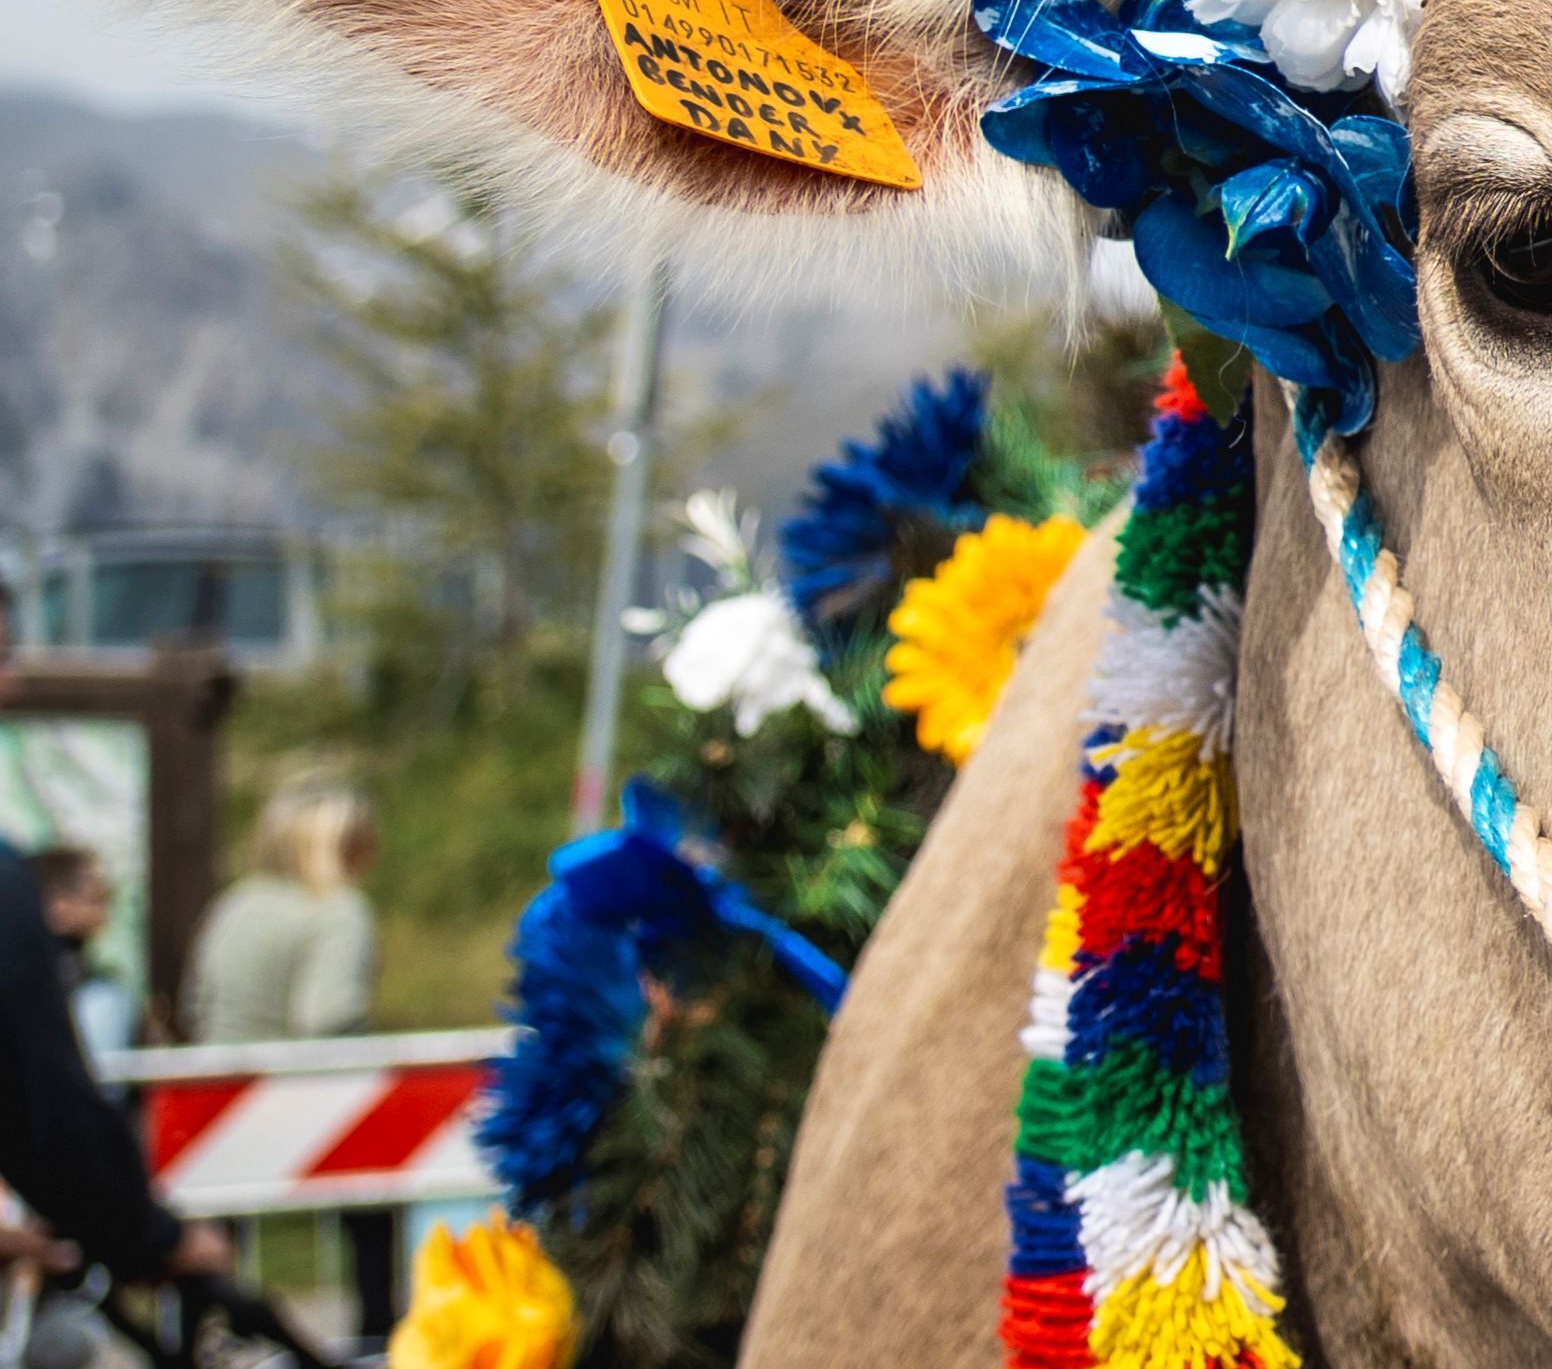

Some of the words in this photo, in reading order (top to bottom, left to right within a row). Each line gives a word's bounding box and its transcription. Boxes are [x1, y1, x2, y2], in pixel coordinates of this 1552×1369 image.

[719, 0, 752, 34] IT
[637, 53, 822, 140] BENDER
[680, 98, 839, 164] DANY
